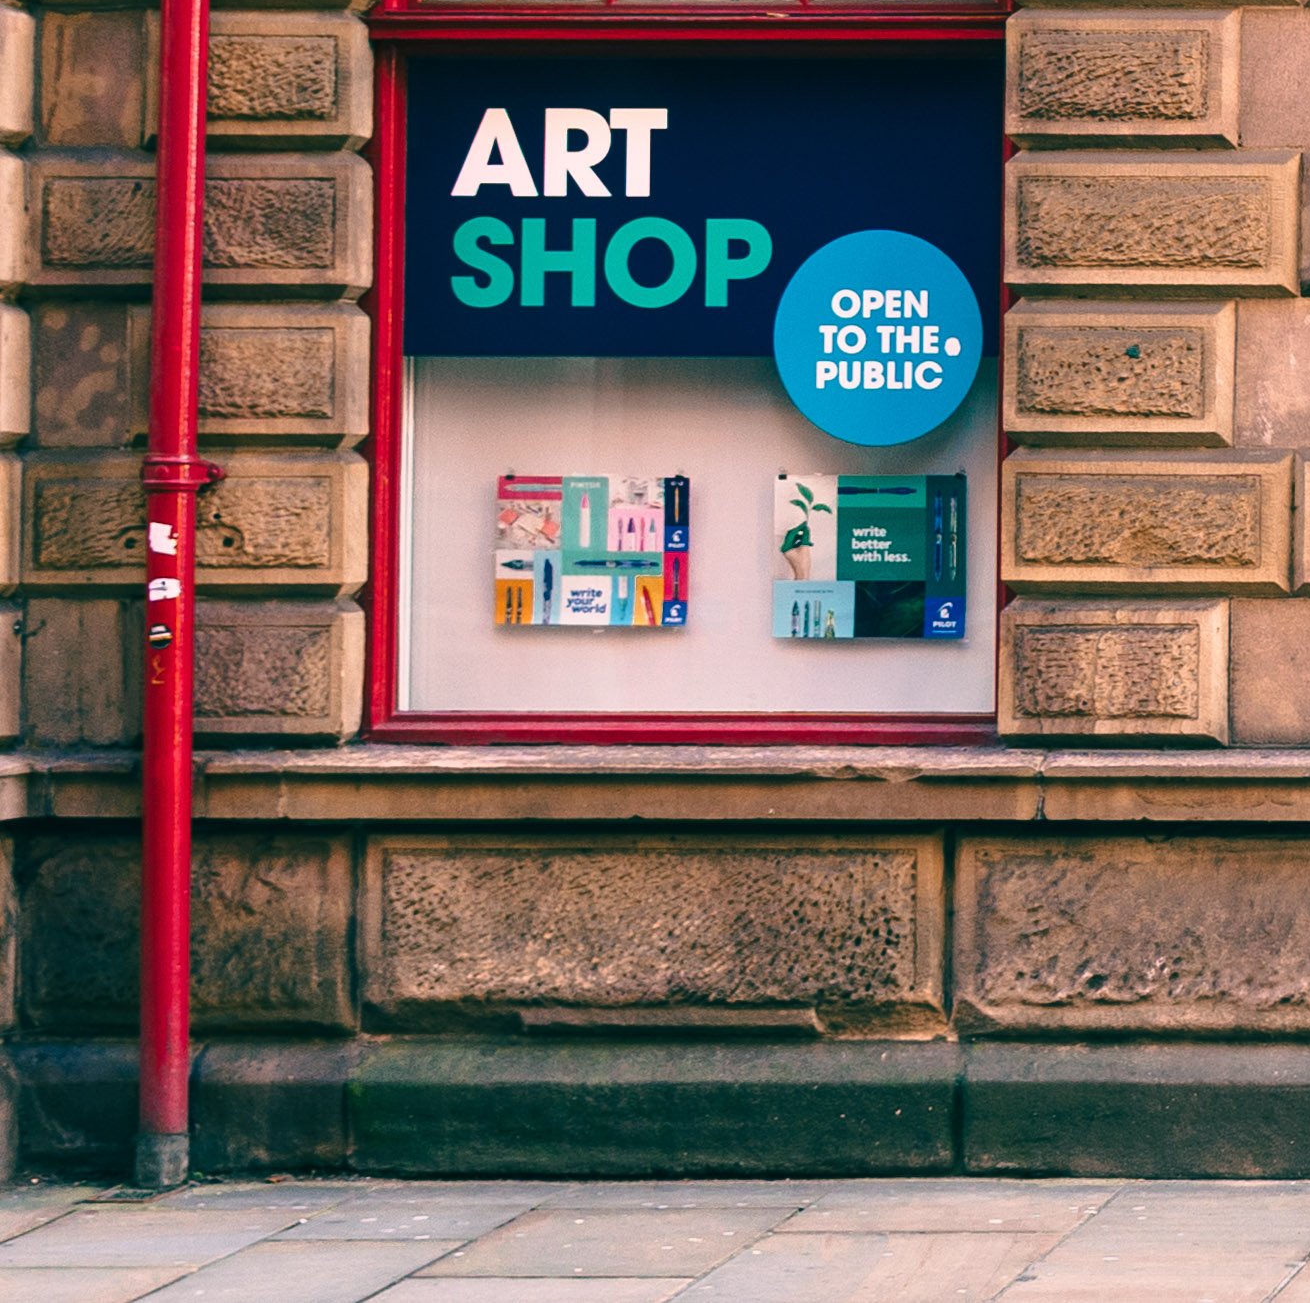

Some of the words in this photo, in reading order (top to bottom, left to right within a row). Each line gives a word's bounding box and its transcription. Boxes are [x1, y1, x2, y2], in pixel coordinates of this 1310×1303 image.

[450, 107, 668, 197] ART
[450, 216, 773, 309] SHOP
[831, 289, 929, 319] OPEN
[818, 325, 867, 354] TO
[815, 360, 943, 390] PUBLIC
[852, 526, 887, 537] write
[851, 538, 892, 549] better
[852, 552, 882, 563] with
[884, 551, 912, 563] less.
[570, 589, 603, 597] write
[567, 597, 595, 608] your
[571, 604, 607, 614] world
[932, 620, 957, 628] PILOT
